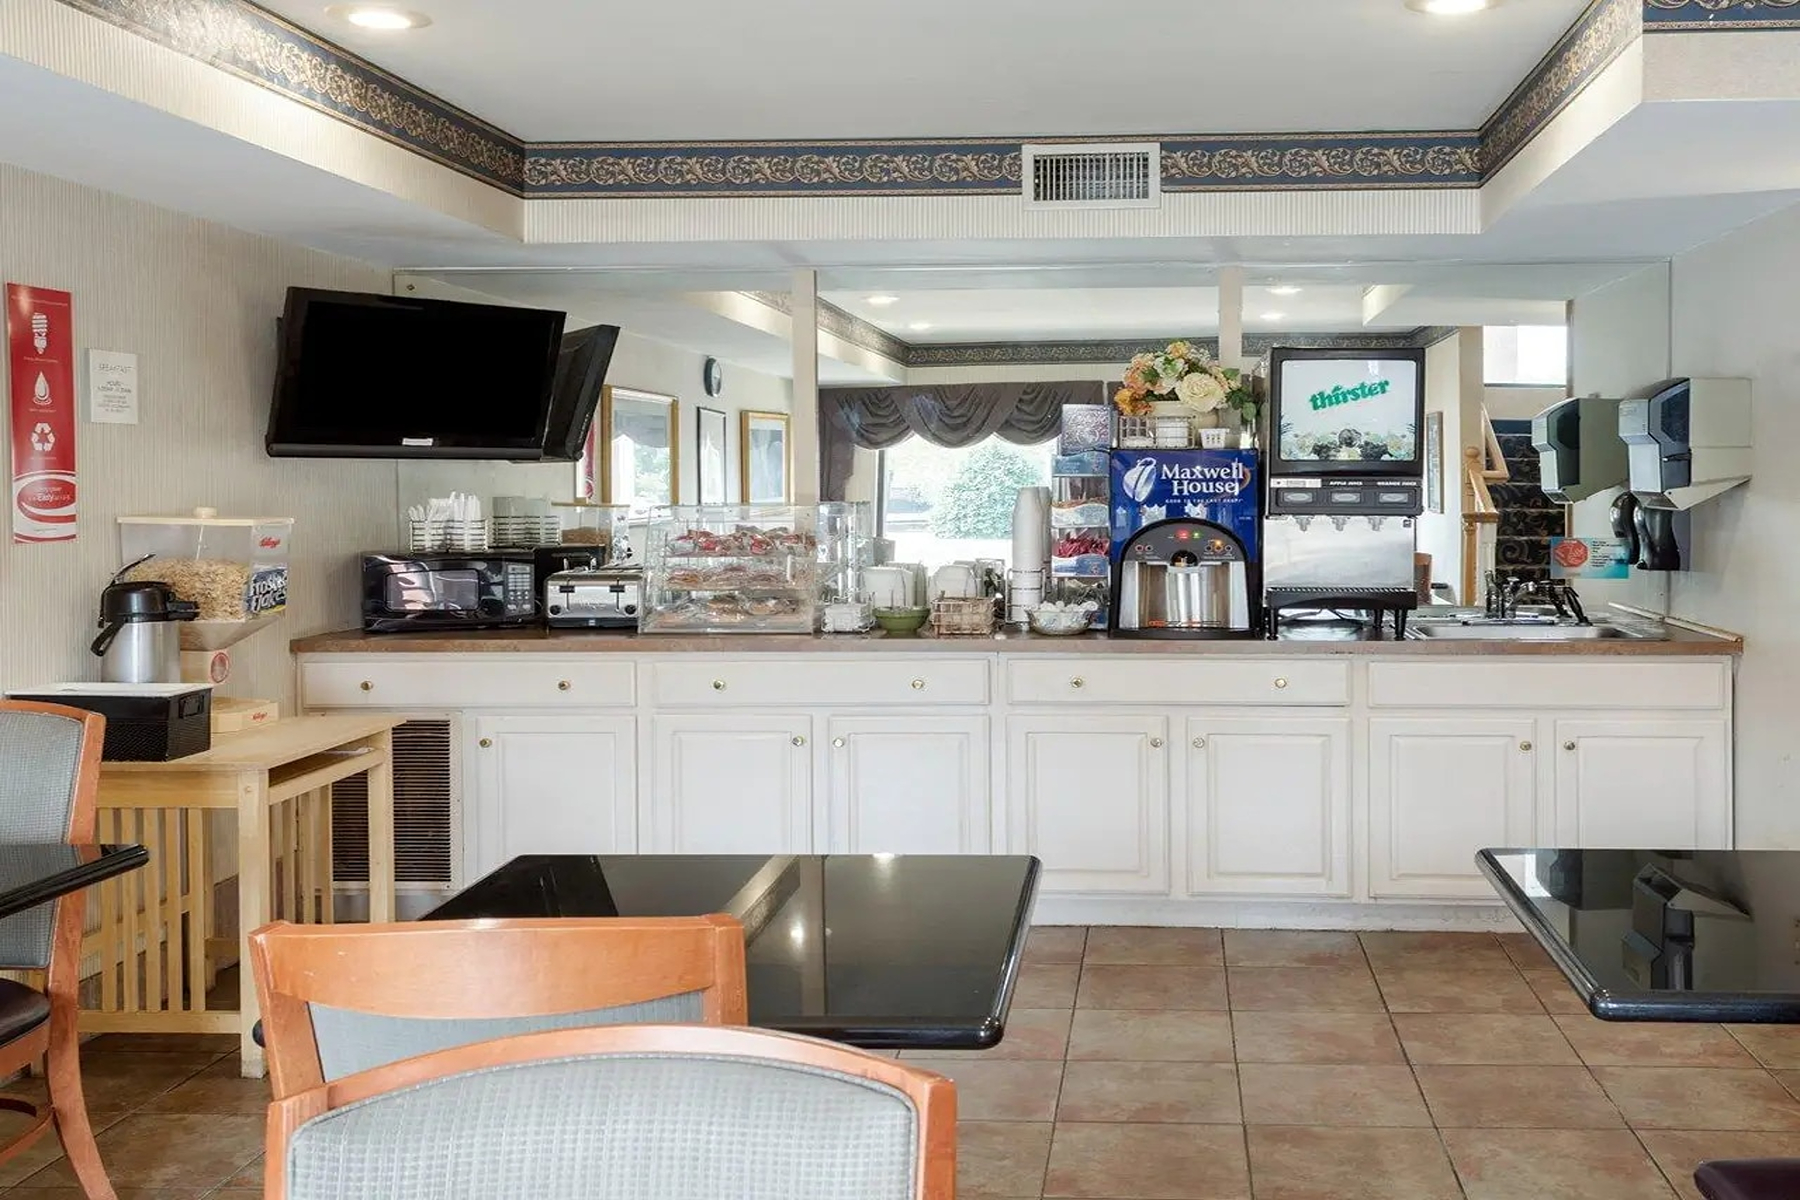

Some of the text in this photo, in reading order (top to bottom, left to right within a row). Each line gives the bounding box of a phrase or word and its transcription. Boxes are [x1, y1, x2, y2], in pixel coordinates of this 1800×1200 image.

[1309, 378, 1390, 411] thirster
[1160, 462, 1244, 479] Maxwell
[1172, 480, 1238, 496] House
